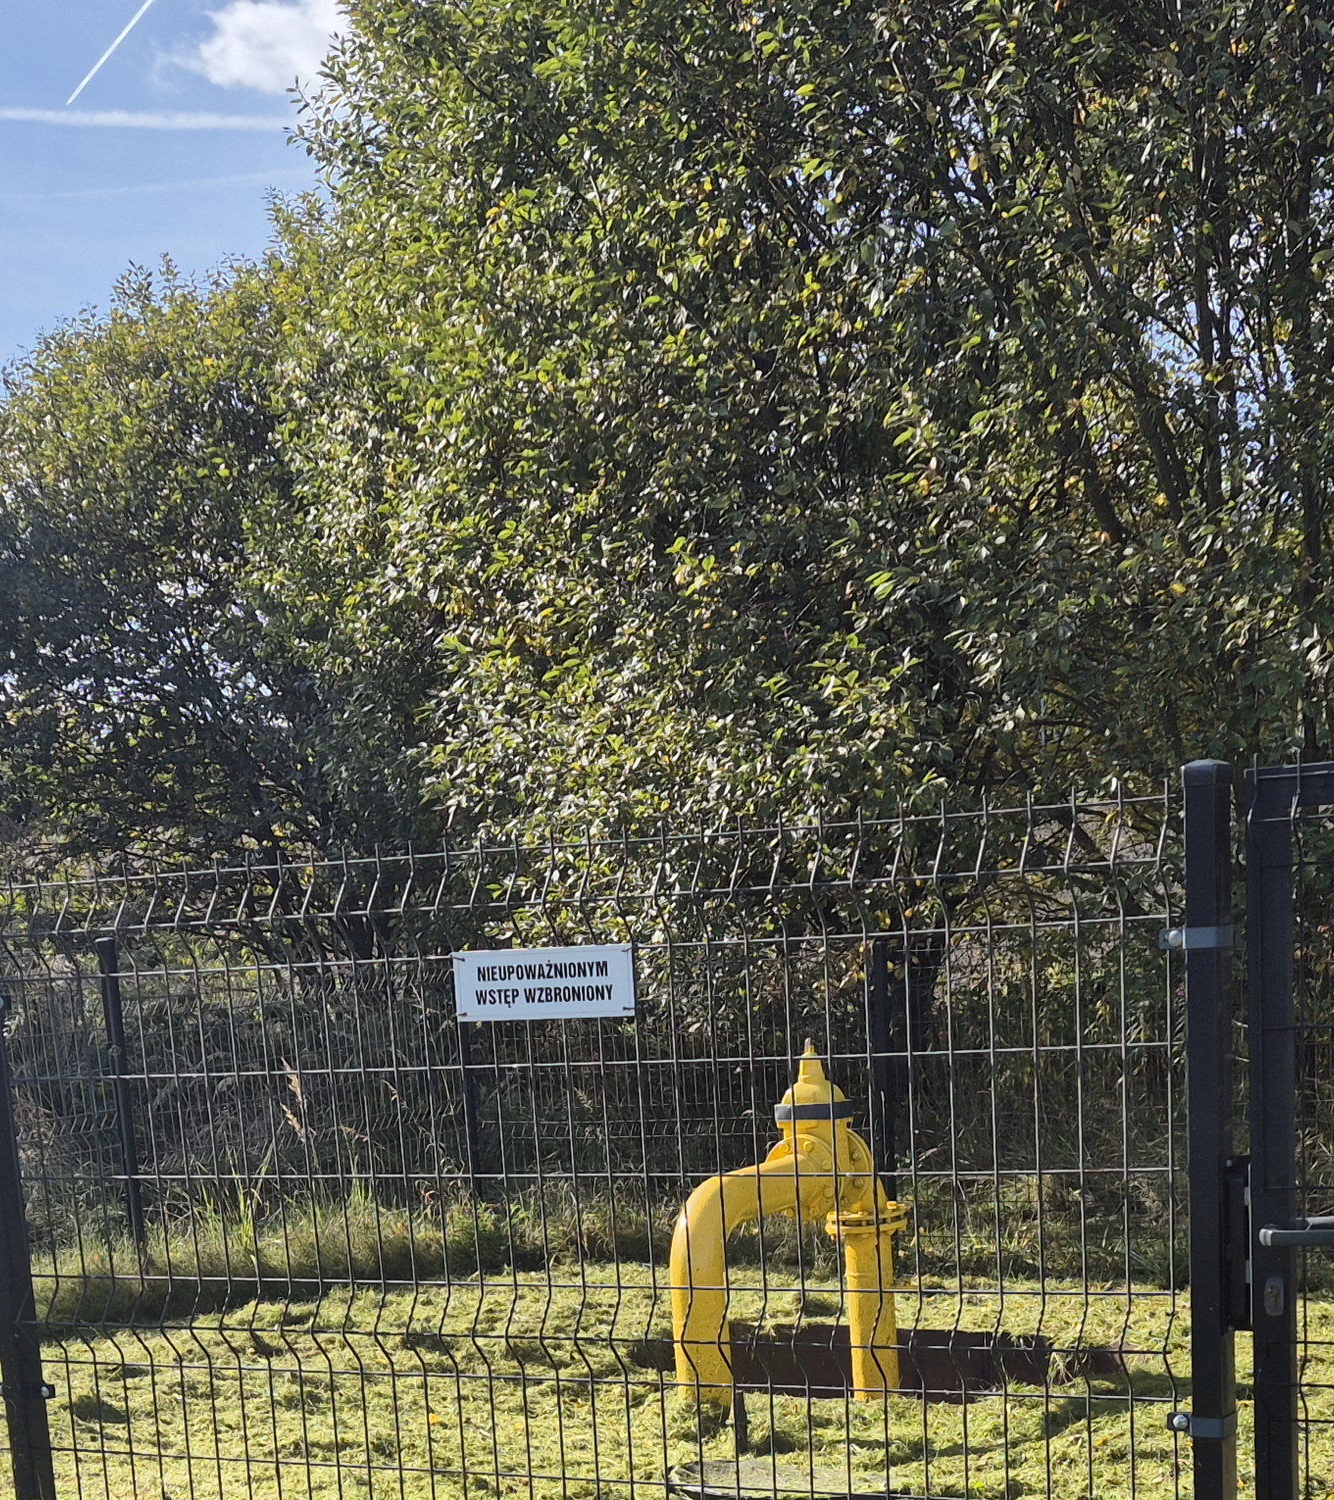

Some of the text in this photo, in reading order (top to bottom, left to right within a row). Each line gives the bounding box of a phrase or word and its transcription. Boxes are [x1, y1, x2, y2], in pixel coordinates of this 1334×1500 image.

[477, 960, 608, 982] NIEUPOWAŻNIONYM
[475, 984, 613, 1008] WSTĘP WZBRONIONY
